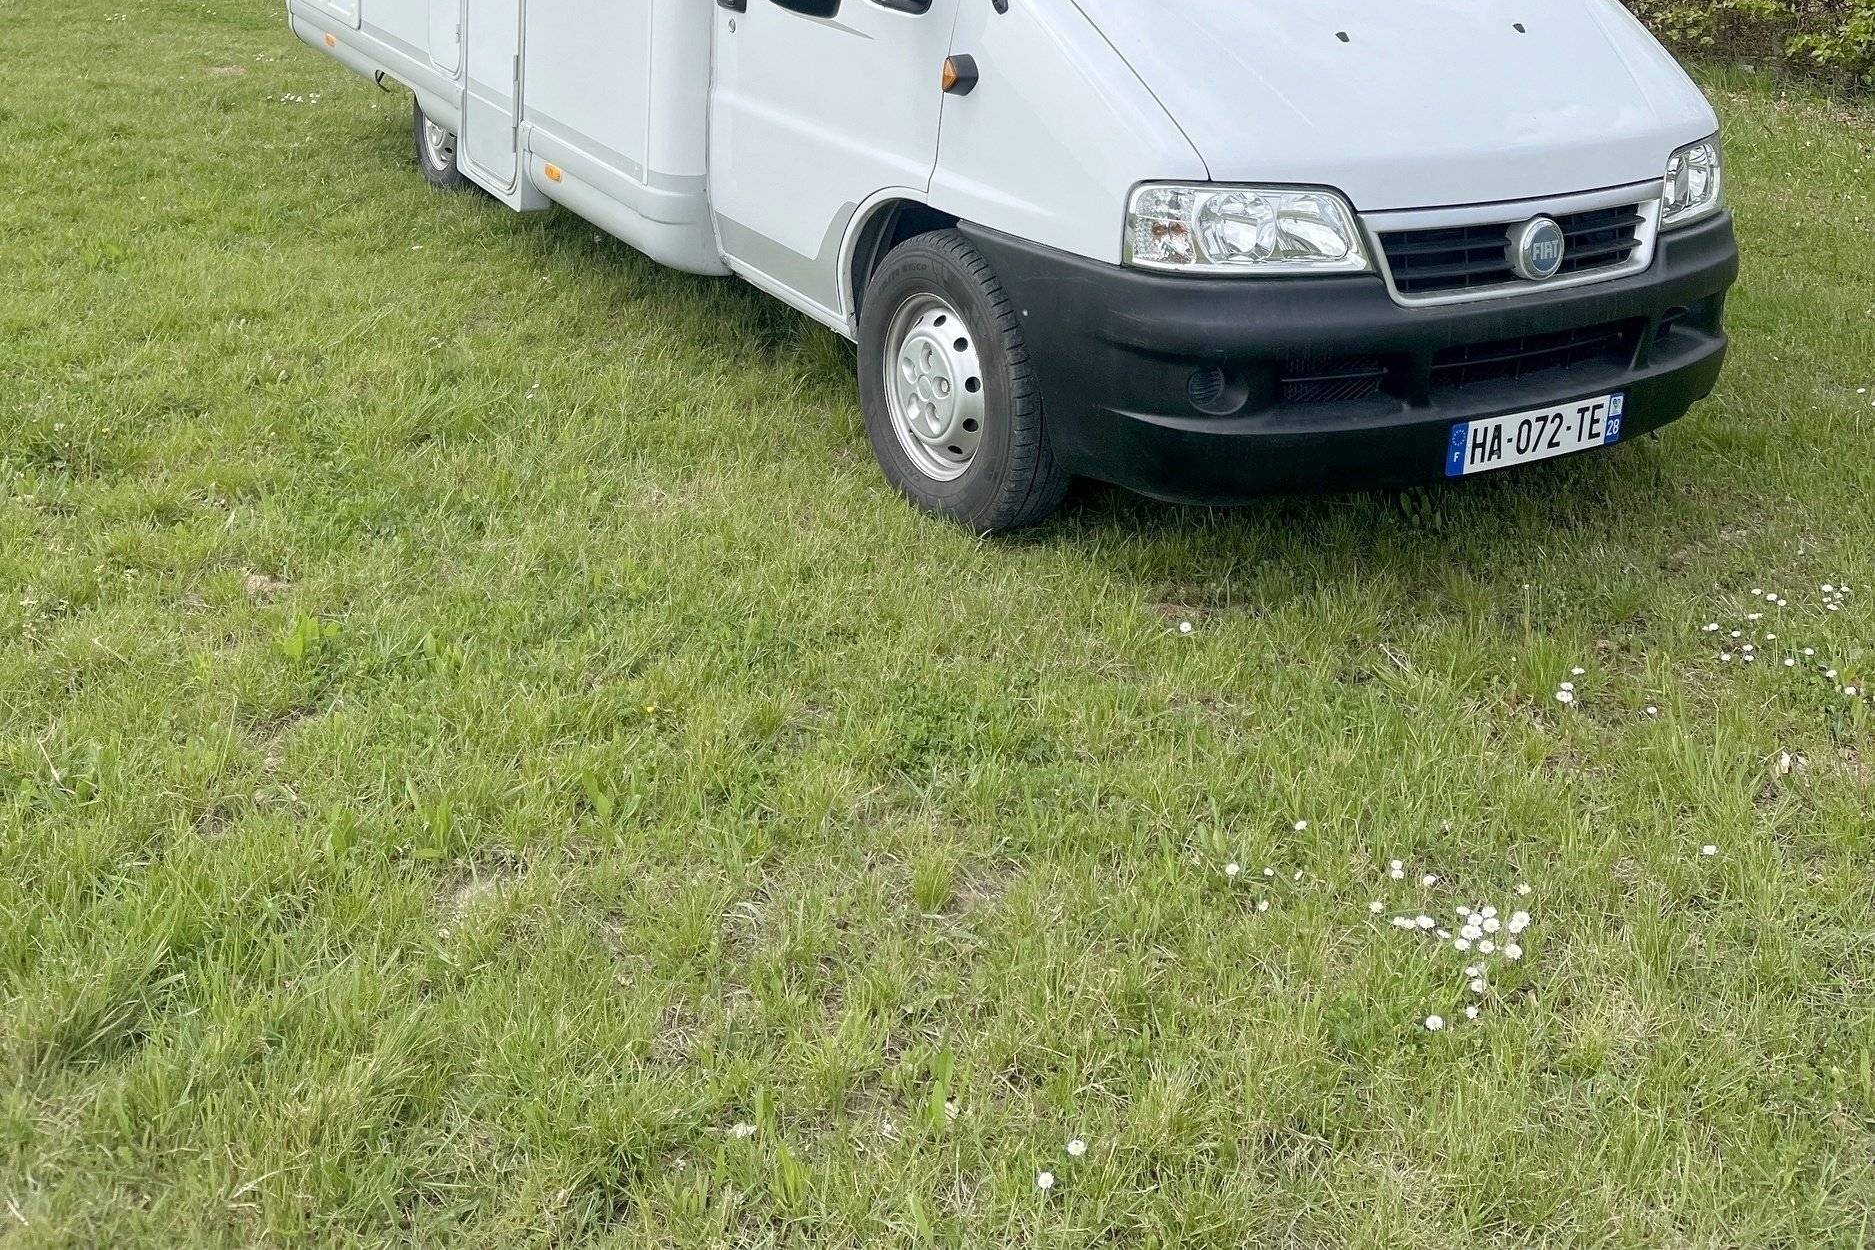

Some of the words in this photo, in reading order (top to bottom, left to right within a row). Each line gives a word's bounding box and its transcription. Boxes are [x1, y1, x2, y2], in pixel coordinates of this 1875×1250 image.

[1532, 239, 1558, 260] FIAT
[1469, 403, 1604, 465] HA-072-TE
[1606, 418, 1620, 436] 28
[1453, 451, 1460, 463] F
